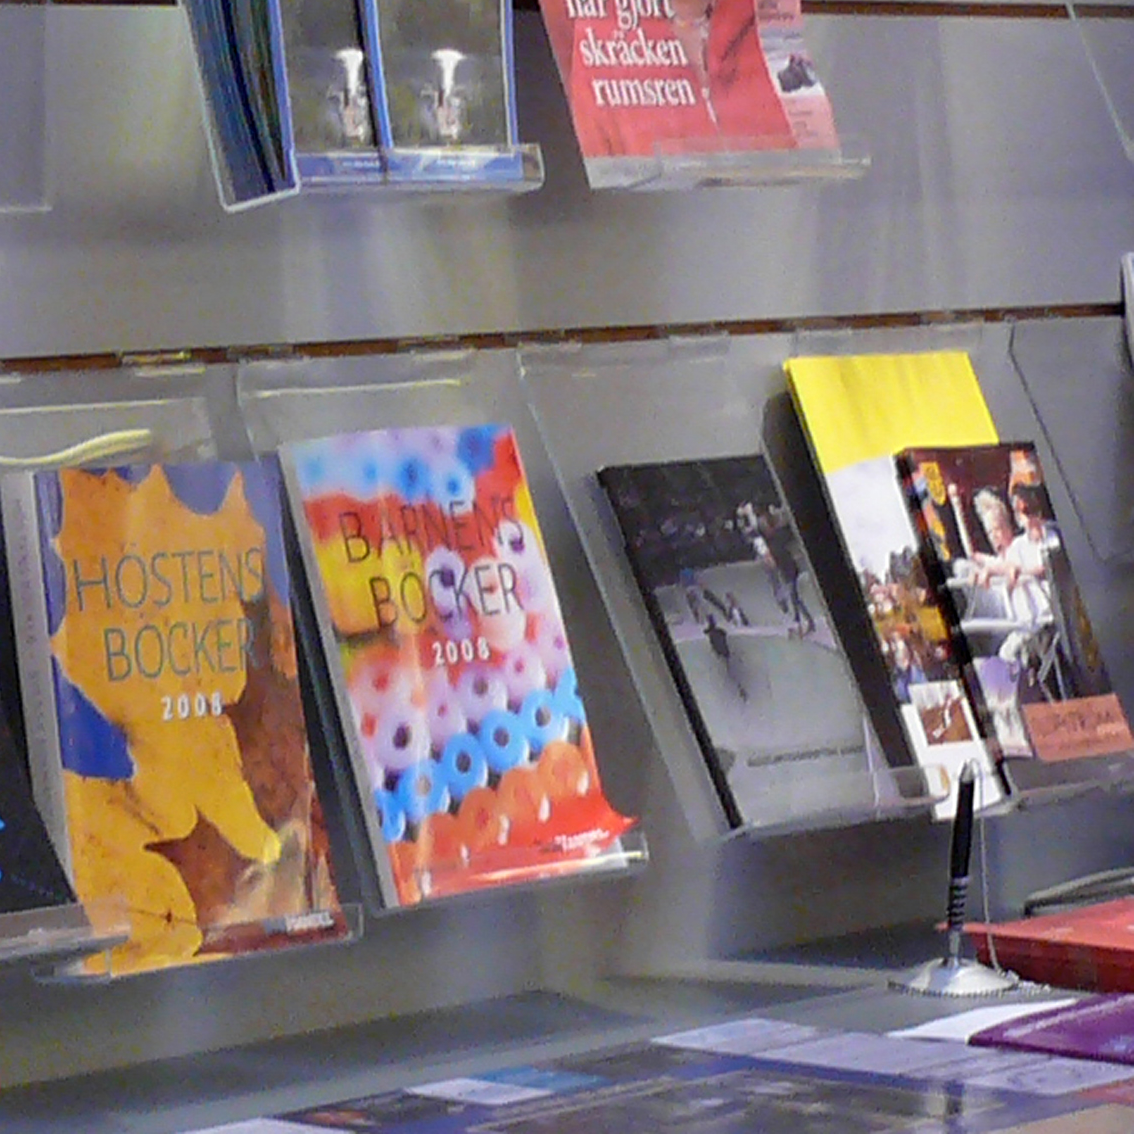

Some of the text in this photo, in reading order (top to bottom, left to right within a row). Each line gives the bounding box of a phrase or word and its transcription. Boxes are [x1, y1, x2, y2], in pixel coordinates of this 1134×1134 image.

[578, 26, 689, 67] skräcken
[590, 76, 697, 107] rumsren
[339, 495, 526, 564] BARNENS
[73, 542, 265, 612] HÖSTENS
[369, 563, 526, 628] BÖCKER
[103, 612, 261, 683] BÖCKER
[431, 636, 490, 667] 2008
[160, 690, 224, 721] 2008
